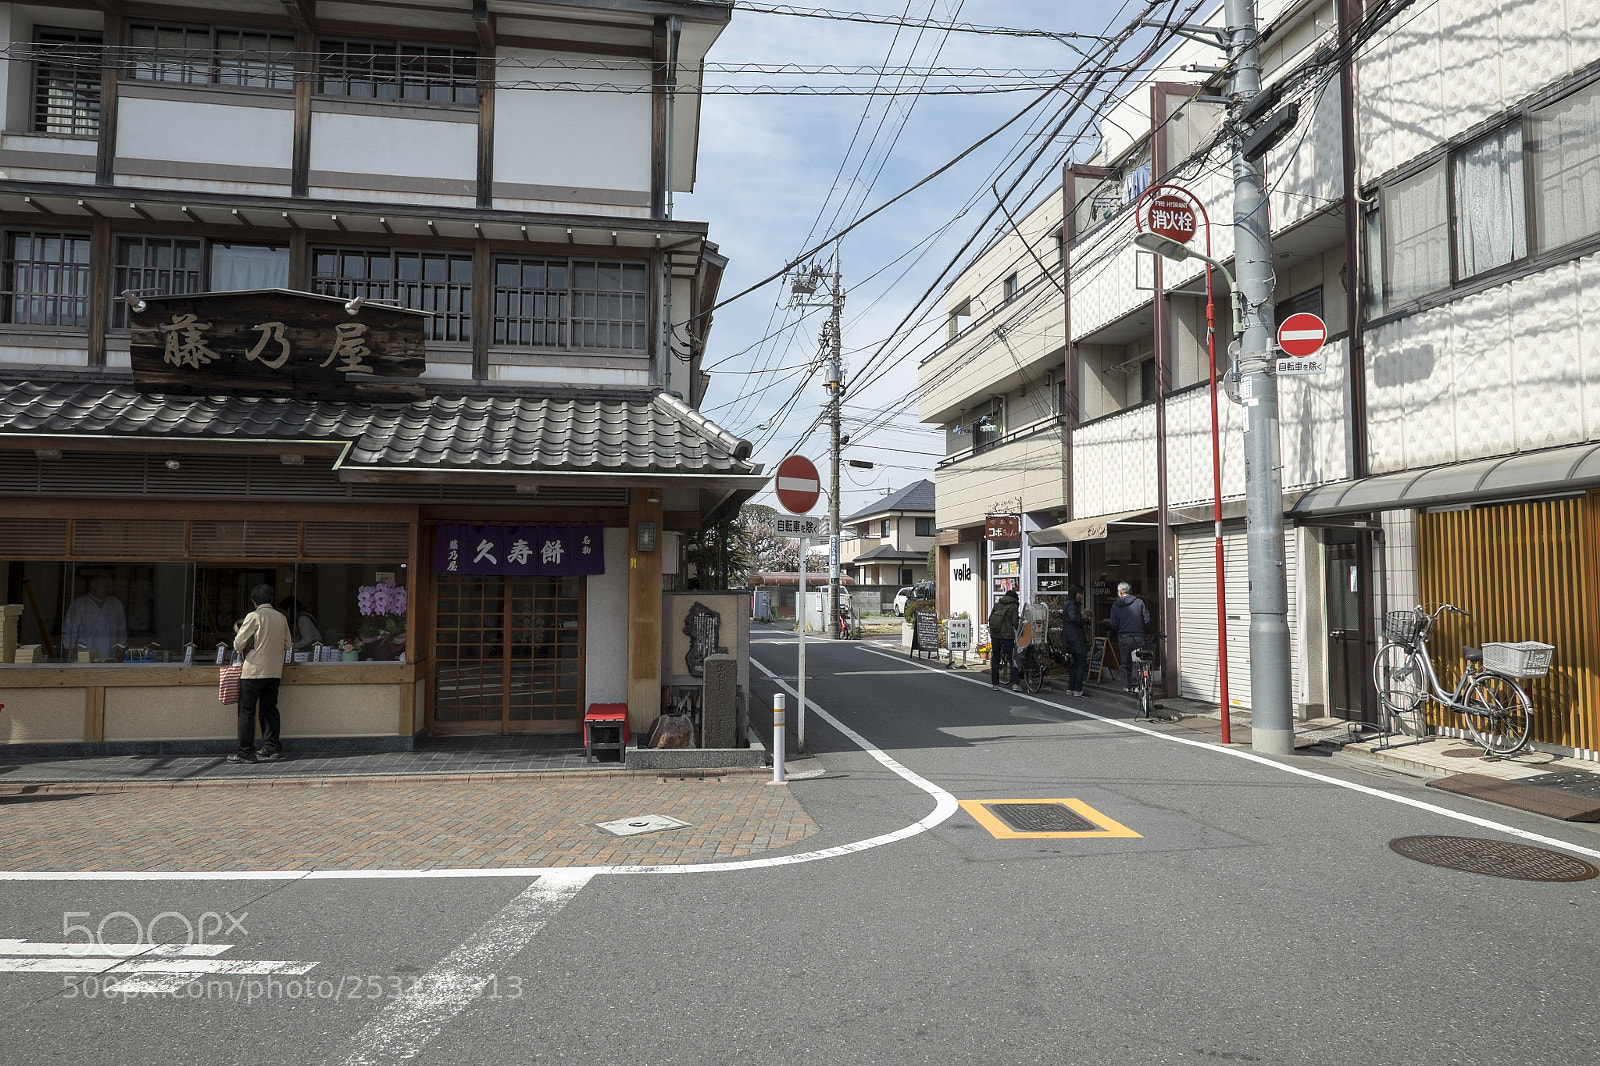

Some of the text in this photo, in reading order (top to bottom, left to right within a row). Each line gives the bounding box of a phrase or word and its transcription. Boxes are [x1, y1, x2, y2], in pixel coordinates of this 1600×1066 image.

[1152, 209, 1193, 232] 消火栓
[163, 313, 374, 374] 藤乃屋
[1278, 361, 1323, 372] 自転車を除く
[777, 519, 818, 534] 自転車を除く
[446, 539, 459, 572] 藤乃屋
[473, 538, 565, 565] 久寿餅
[581, 535, 592, 555] 名物
